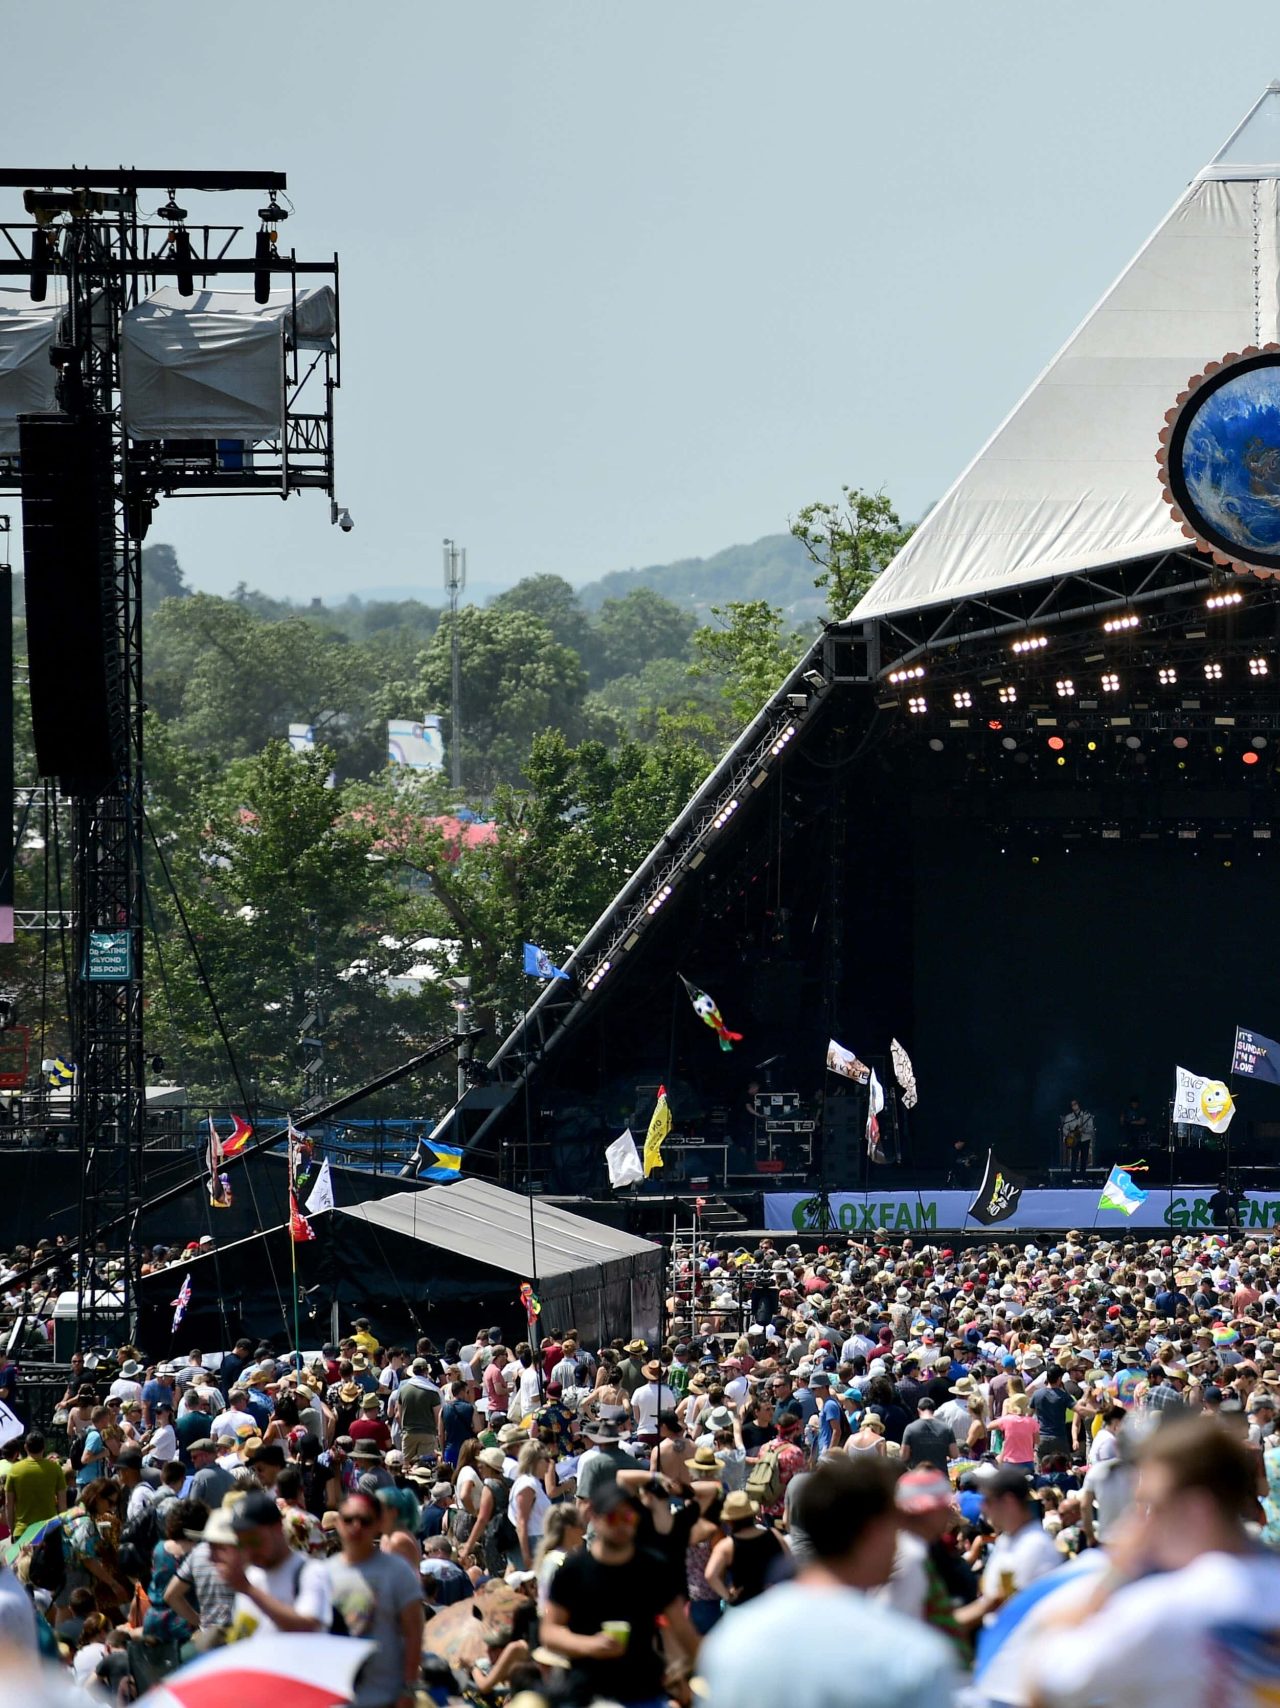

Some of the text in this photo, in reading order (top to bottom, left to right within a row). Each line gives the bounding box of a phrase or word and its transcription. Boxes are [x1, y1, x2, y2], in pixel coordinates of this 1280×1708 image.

[103, 965, 126, 973] POINT
[1238, 1031, 1253, 1043] IT'S
[1237, 1041, 1267, 1057] SUNDAY
[1236, 1050, 1248, 1062] I'M
[839, 1063, 870, 1080] KYLIE
[1235, 1060, 1254, 1073] LOVE
[839, 1201, 938, 1230] OXFAM
